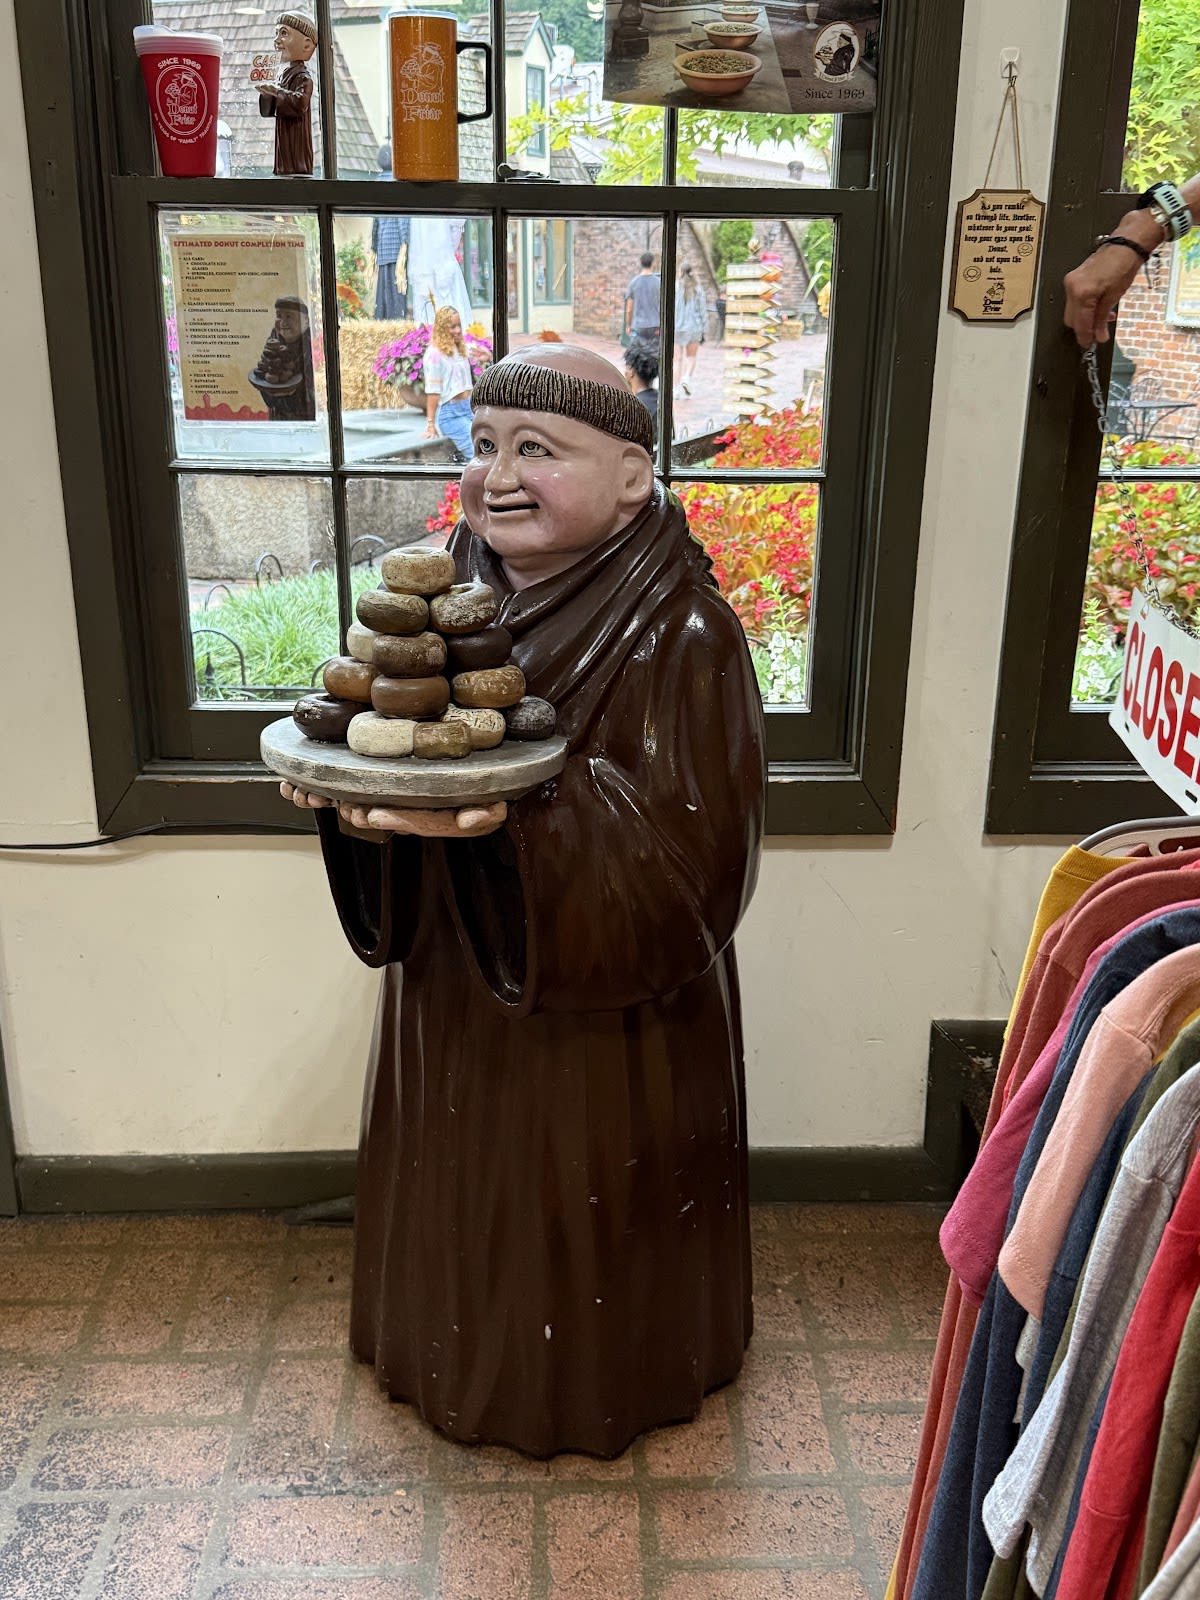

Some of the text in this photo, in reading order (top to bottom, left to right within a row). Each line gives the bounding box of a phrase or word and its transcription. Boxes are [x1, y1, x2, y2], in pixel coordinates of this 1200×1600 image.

[157, 57, 202, 70] SINCE 1969
[399, 87, 445, 105] Donut
[804, 88, 865, 99] Since 1969
[166, 102, 198, 115] Donut
[402, 104, 442, 122] Friar
[168, 113, 196, 126] Friar
[980, 202, 1025, 212] As you ramble
[975, 213, 998, 222] through
[1002, 225, 1018, 233] your
[173, 240, 212, 248] ESTIMATED
[213, 240, 239, 248] DONUT
[240, 240, 286, 248] COMPLETION
[964, 234, 978, 243] keep
[978, 236, 993, 244] your
[994, 236, 1008, 244] eyes
[1008, 236, 1023, 244] upon
[996, 256, 1011, 265] upon
[1123, 621, 1200, 786] CLOSE
